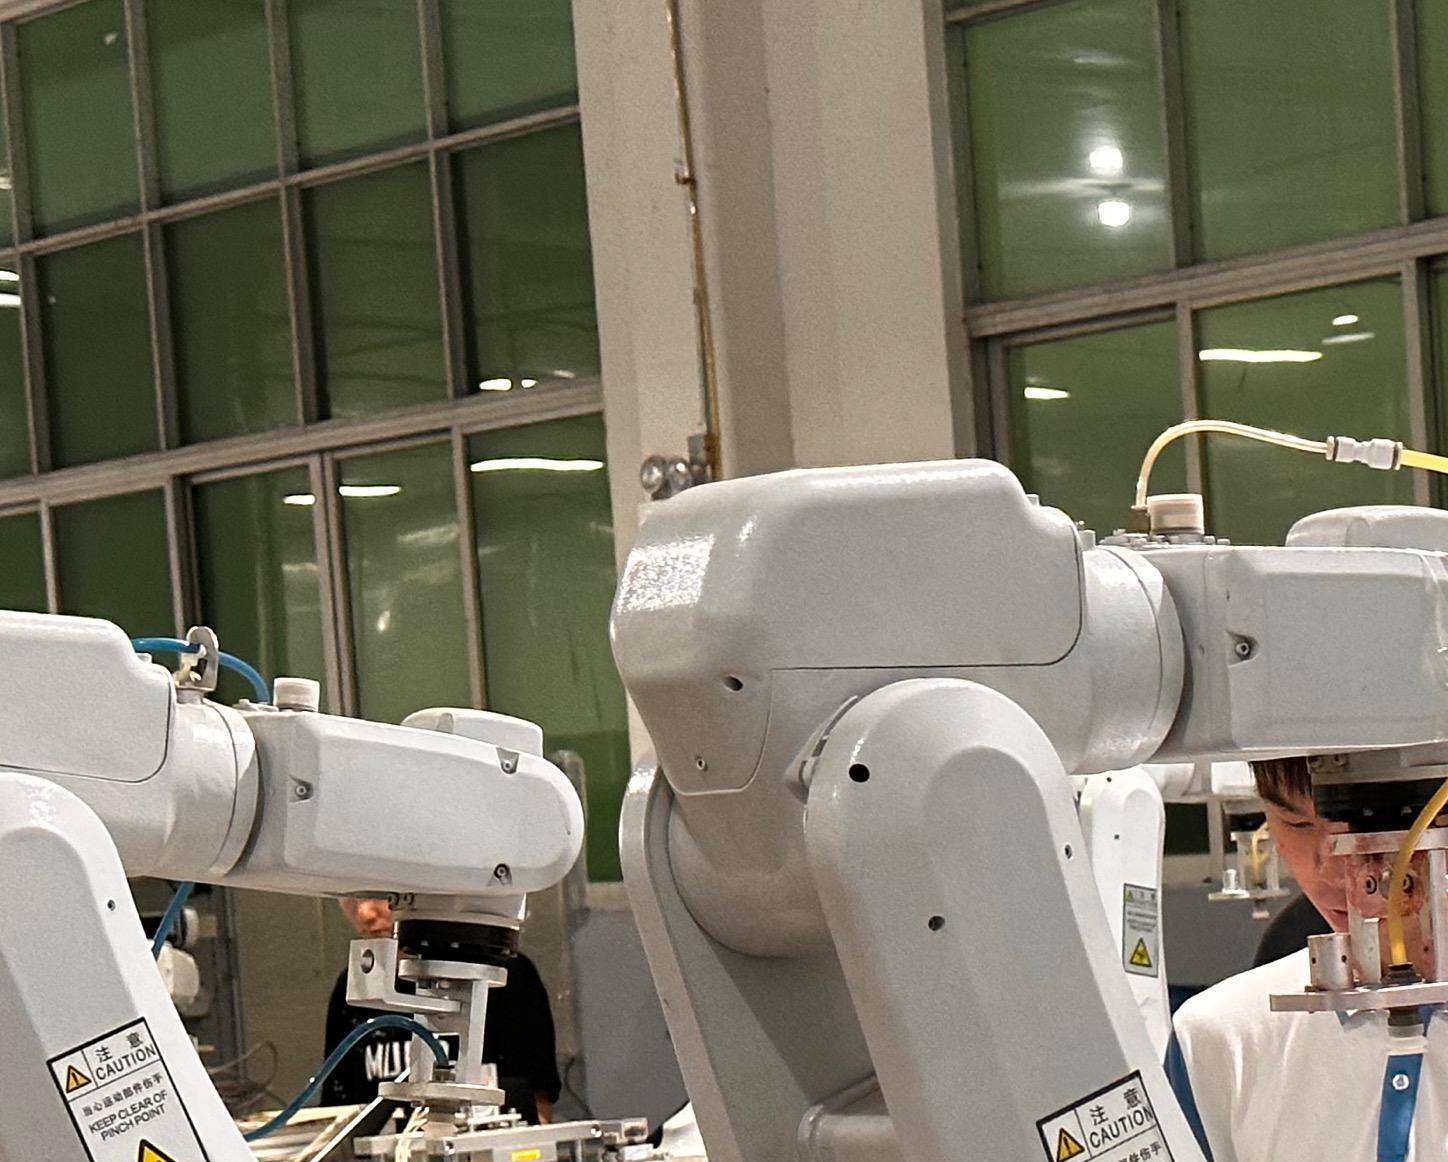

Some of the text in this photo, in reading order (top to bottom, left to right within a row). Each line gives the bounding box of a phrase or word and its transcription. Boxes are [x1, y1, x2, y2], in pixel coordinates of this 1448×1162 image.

[96, 1043, 156, 1080] CAUTION
[89, 1089, 168, 1134] KEEP CLEAR OF
[101, 1103, 165, 1141] PINCH POINT
[1089, 1106, 1154, 1148] CAUTION
